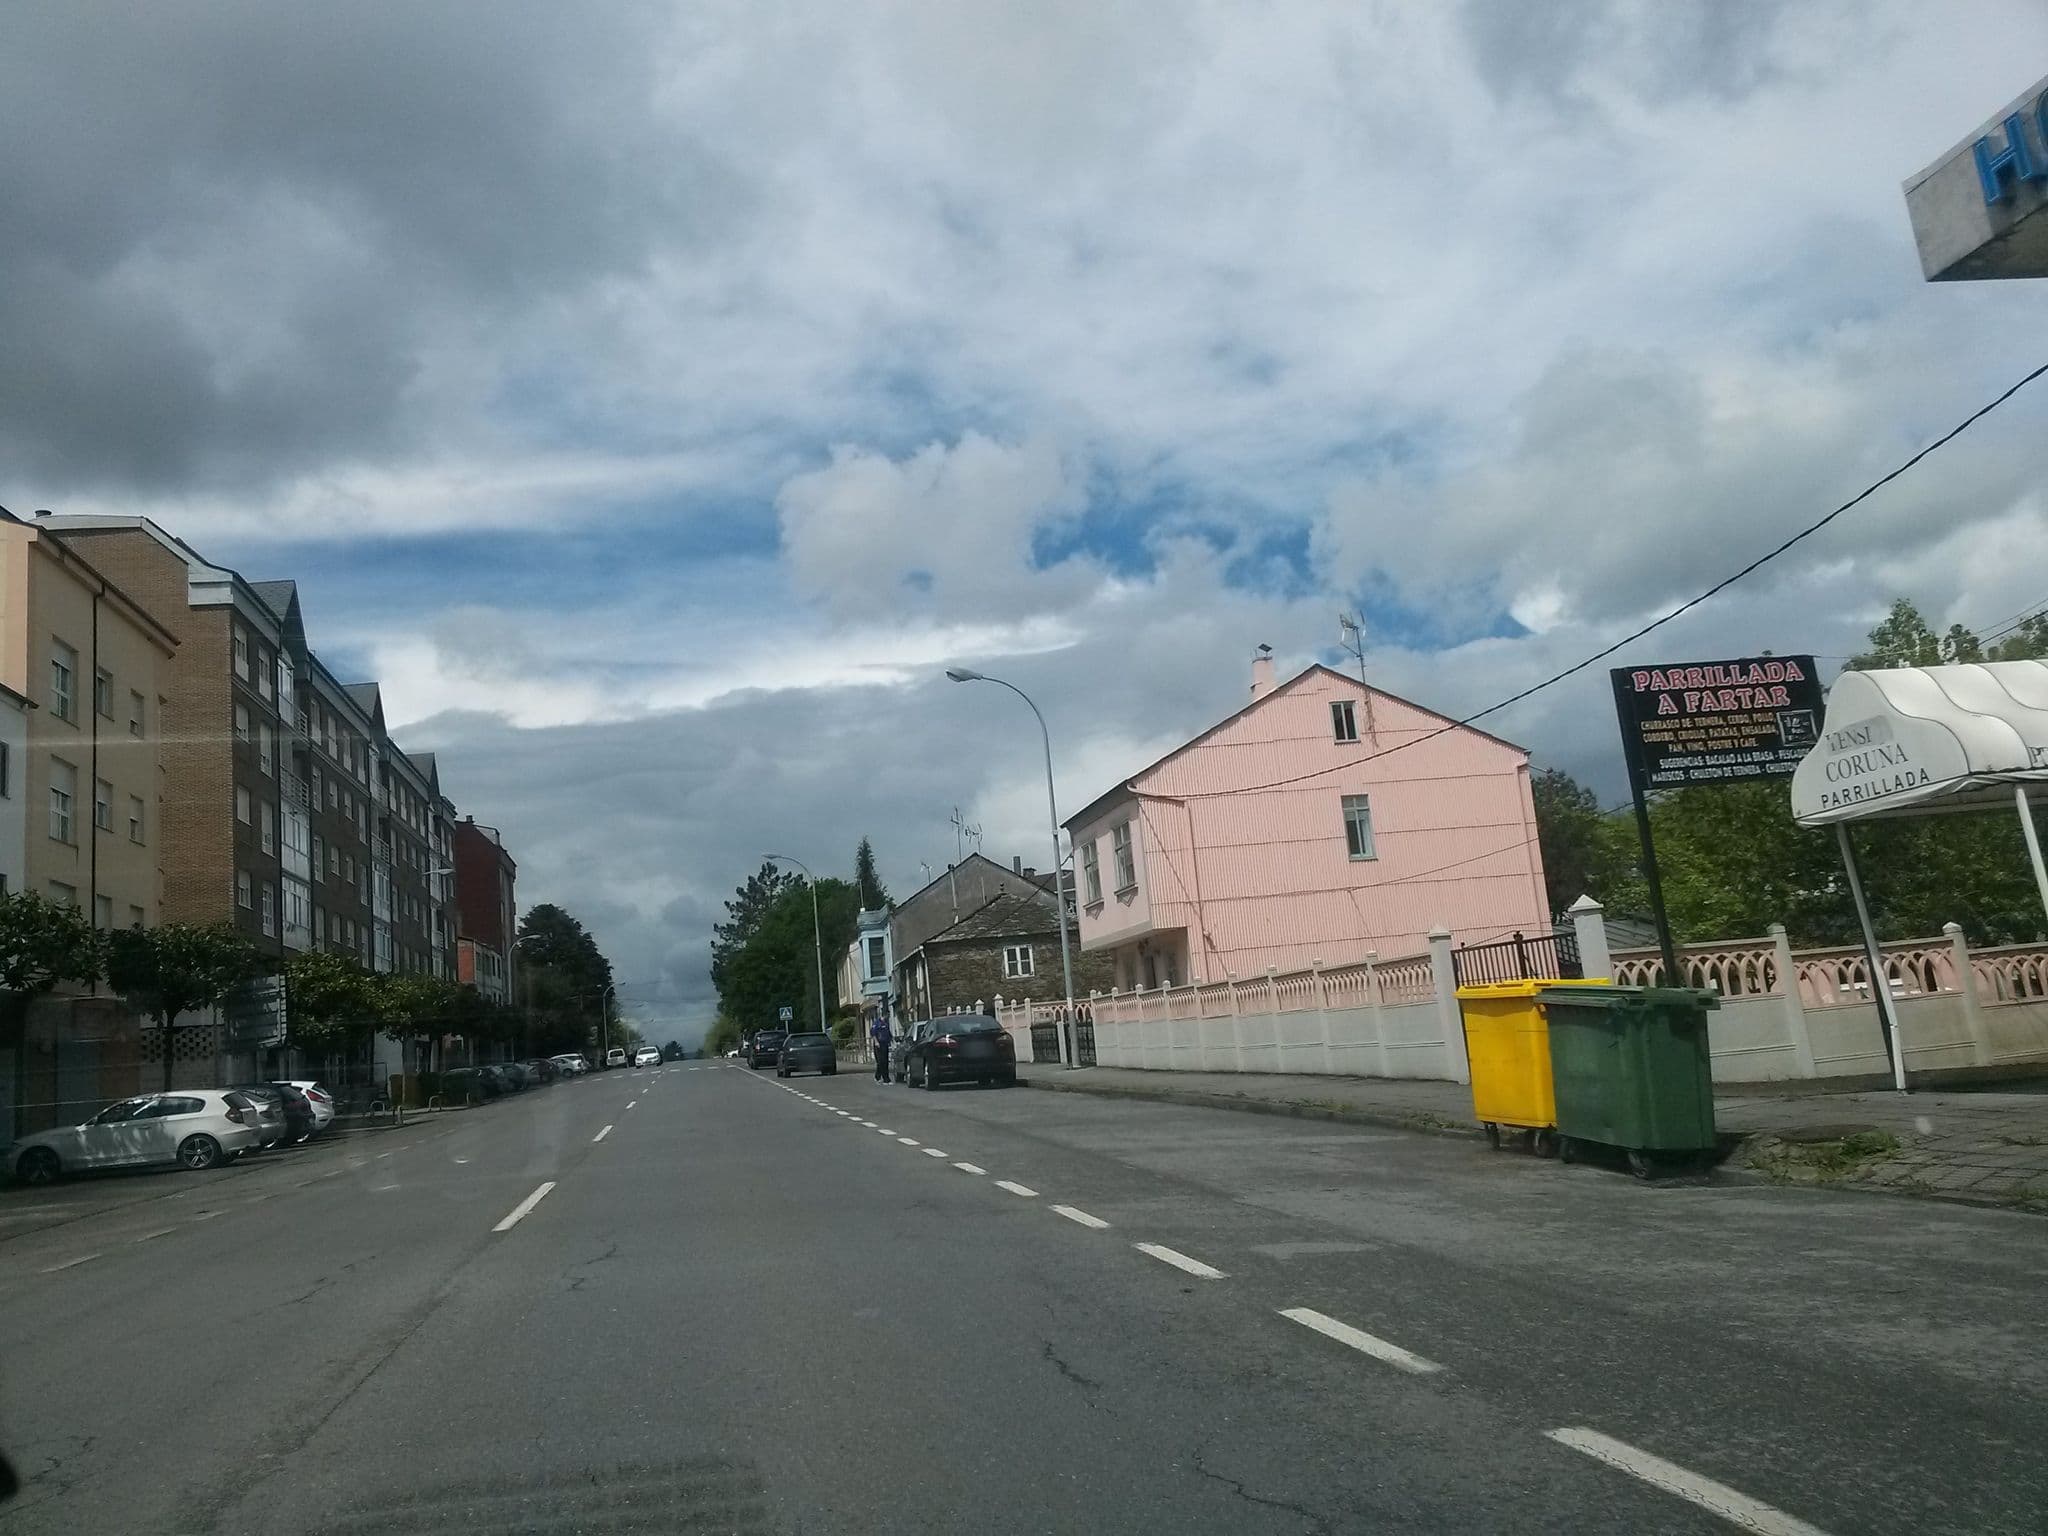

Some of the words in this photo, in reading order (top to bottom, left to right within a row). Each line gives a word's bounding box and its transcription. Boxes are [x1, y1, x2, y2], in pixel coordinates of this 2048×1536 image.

[1973, 86, 2048, 206] H
[1632, 660, 1805, 692] PARRILLADA
[1657, 693, 1679, 715] A
[1684, 685, 1791, 712] FARTAR
[1821, 767, 1930, 809] PARRILLADA
